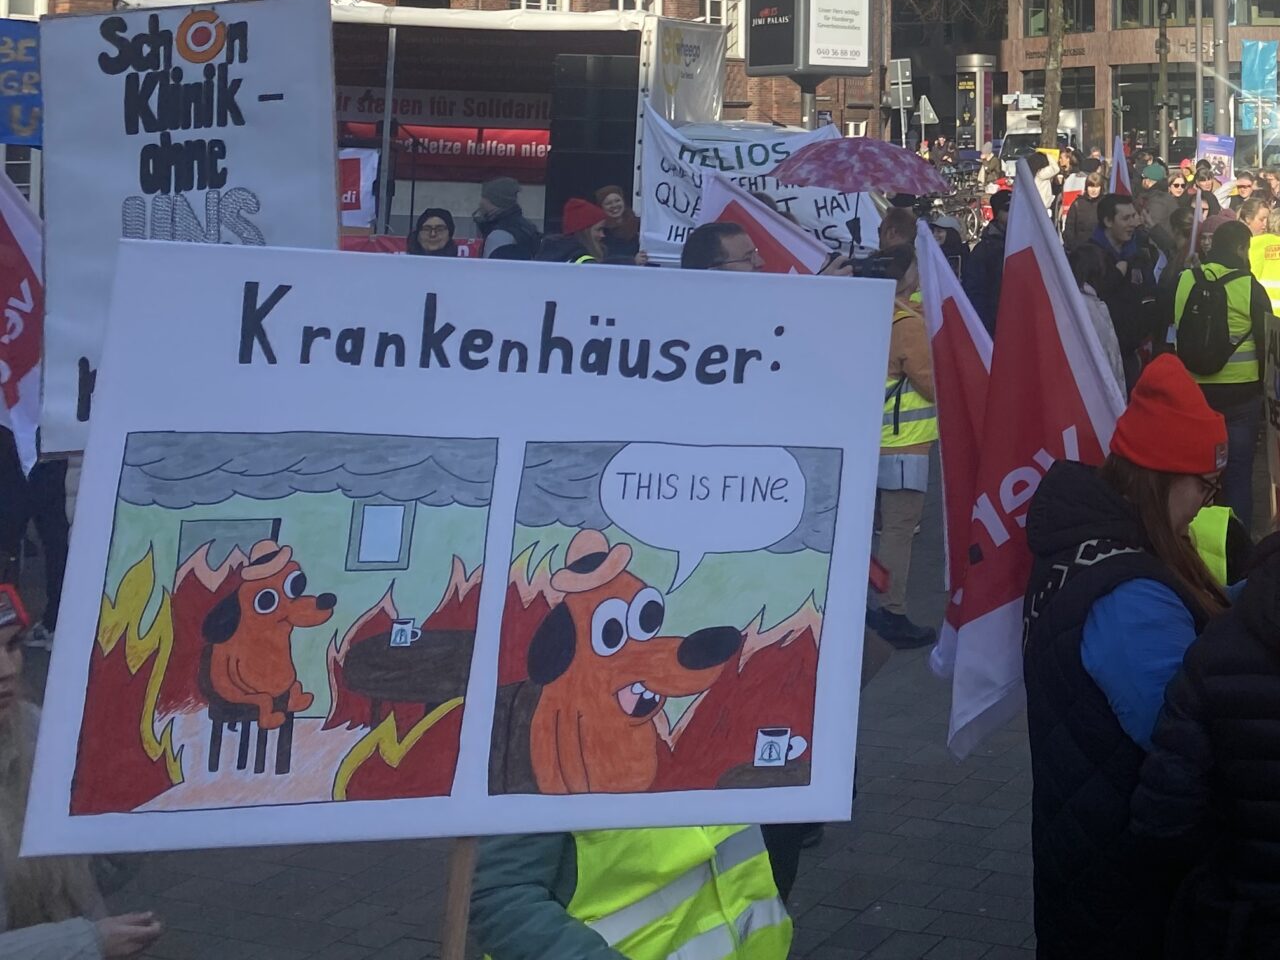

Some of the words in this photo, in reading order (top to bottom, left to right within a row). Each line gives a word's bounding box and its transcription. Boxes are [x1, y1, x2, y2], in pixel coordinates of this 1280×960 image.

[817, 48, 830, 56] 040
[831, 48, 839, 57] 36
[850, 49, 861, 57] 100
[124, 62, 246, 136] Klinik
[463, 97, 552, 121] Solidarit
[140, 131, 228, 195] ohne
[466, 140, 516, 157] helfen
[238, 281, 785, 385] Krankenhäuser:
[616, 472, 680, 501] THIS
[690, 474, 711, 501] IS
